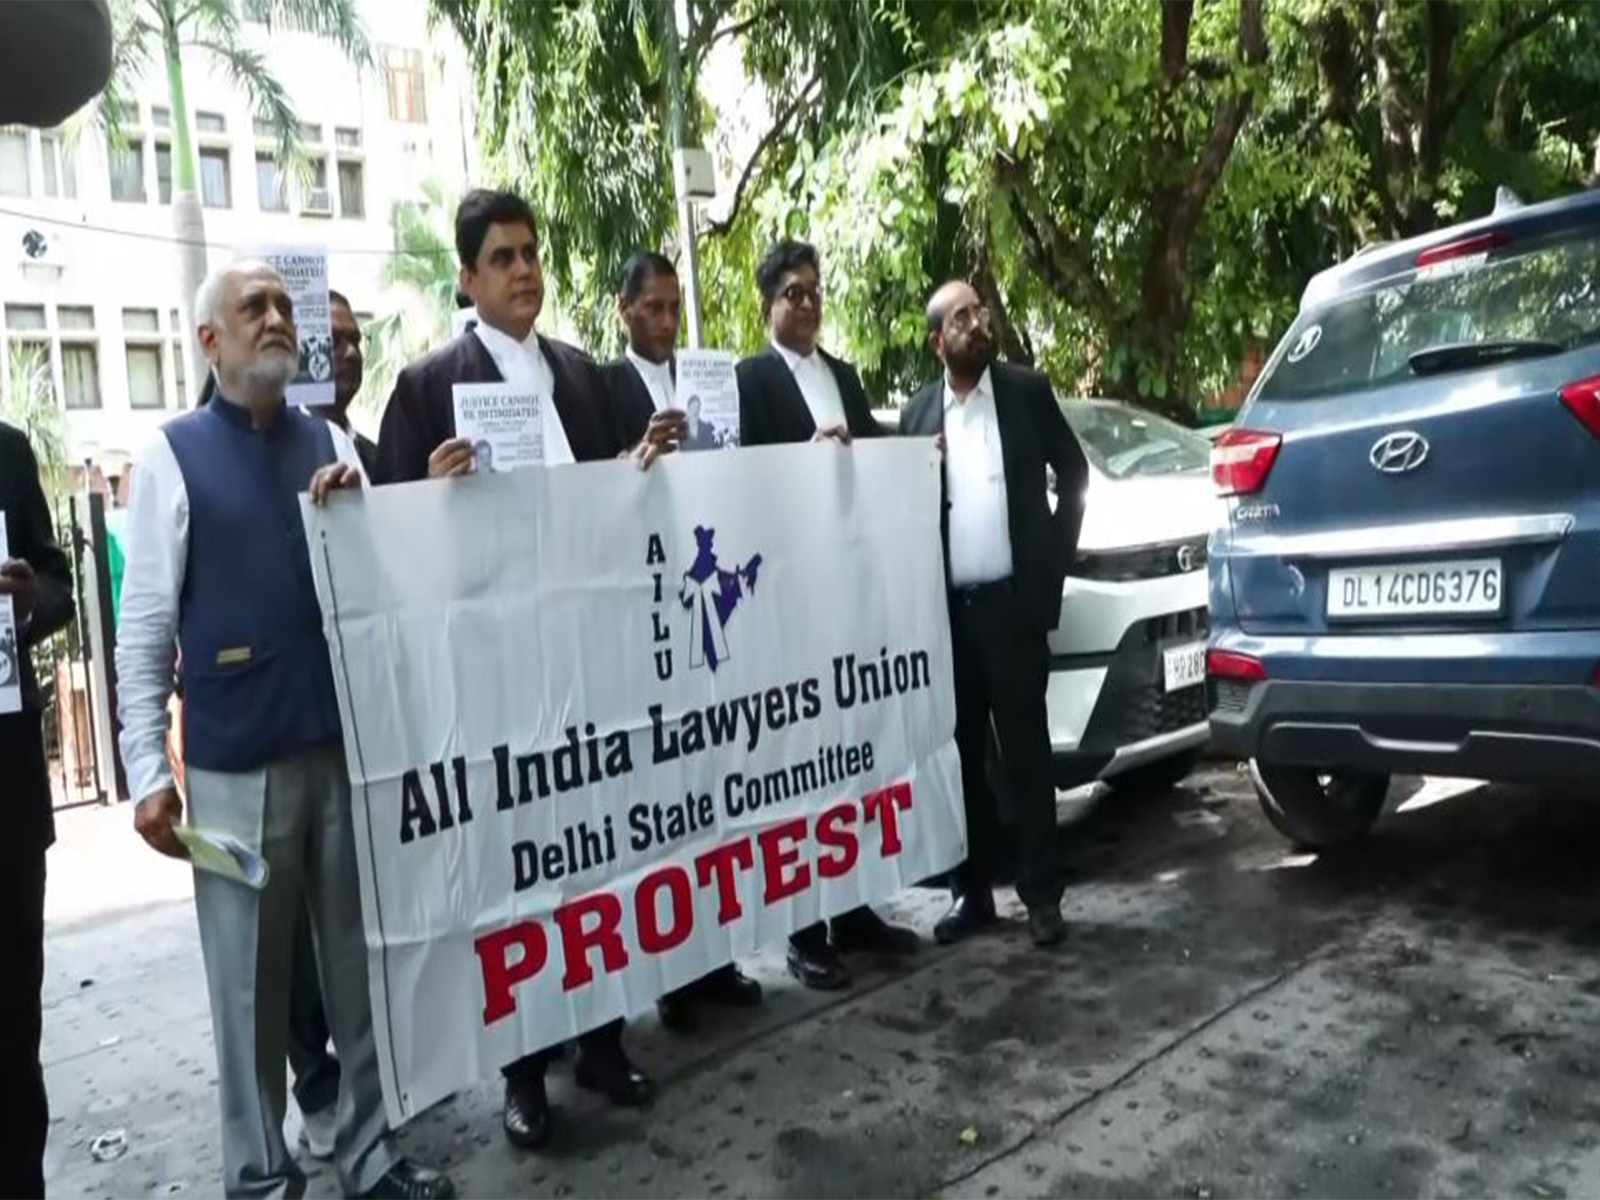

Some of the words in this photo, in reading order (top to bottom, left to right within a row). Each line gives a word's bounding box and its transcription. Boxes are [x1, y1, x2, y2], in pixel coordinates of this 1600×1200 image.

[1343, 569, 1498, 608] DL14CD6376
[400, 754, 474, 845] All
[492, 722, 633, 812] India
[648, 678, 821, 766] Lawyers
[832, 646, 931, 709] Union
[511, 815, 616, 892] Delhi
[628, 790, 715, 852] State
[723, 740, 875, 818] Committee
[473, 782, 914, 1026] PROTEST
